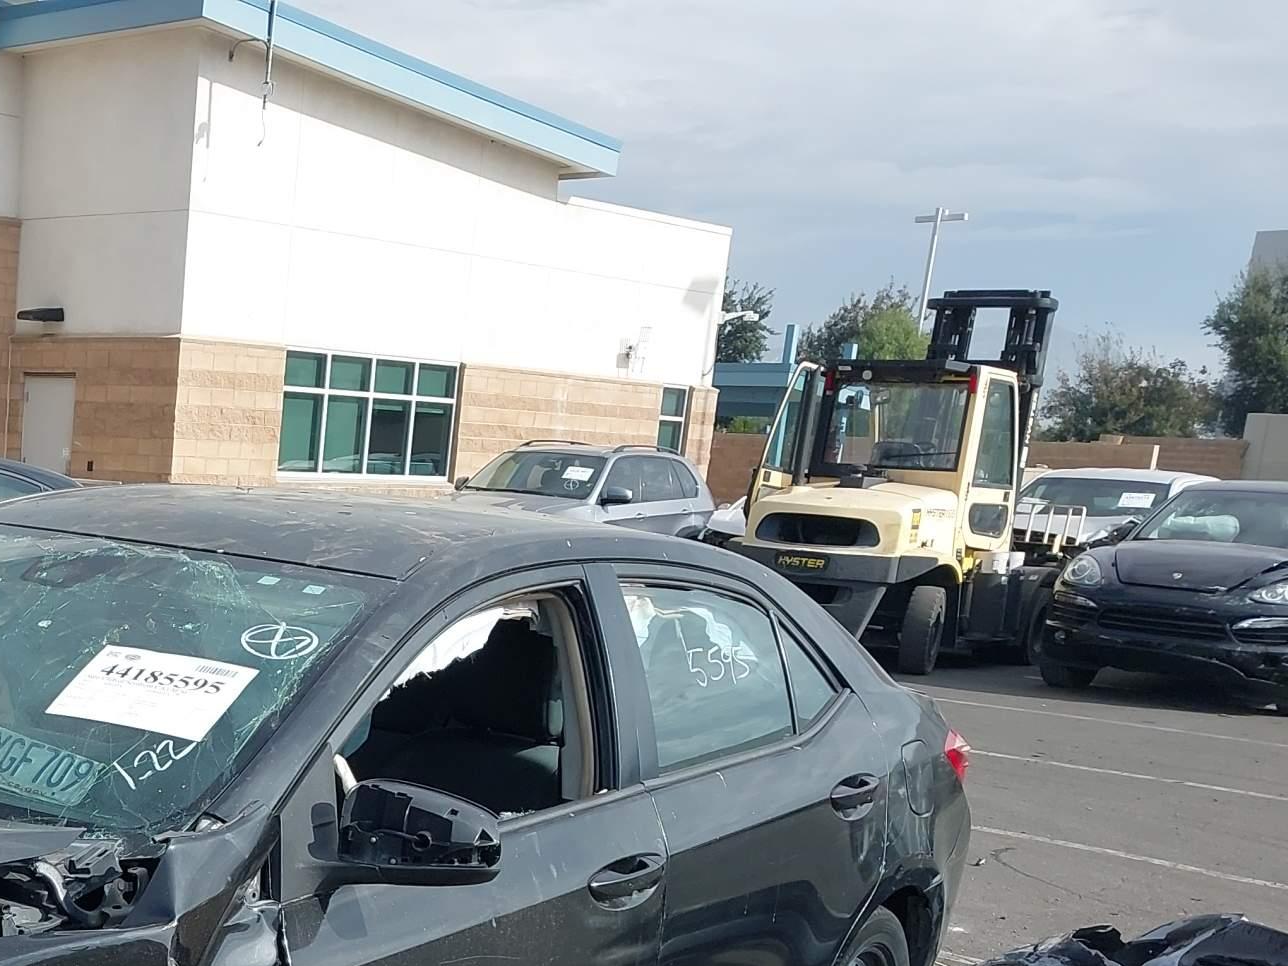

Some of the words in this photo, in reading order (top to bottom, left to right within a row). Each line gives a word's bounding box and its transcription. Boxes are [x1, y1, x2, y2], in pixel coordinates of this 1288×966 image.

[777, 555, 826, 569] HYSTER
[100, 663, 226, 695] 44185595
[686, 645, 751, 688] 5595
